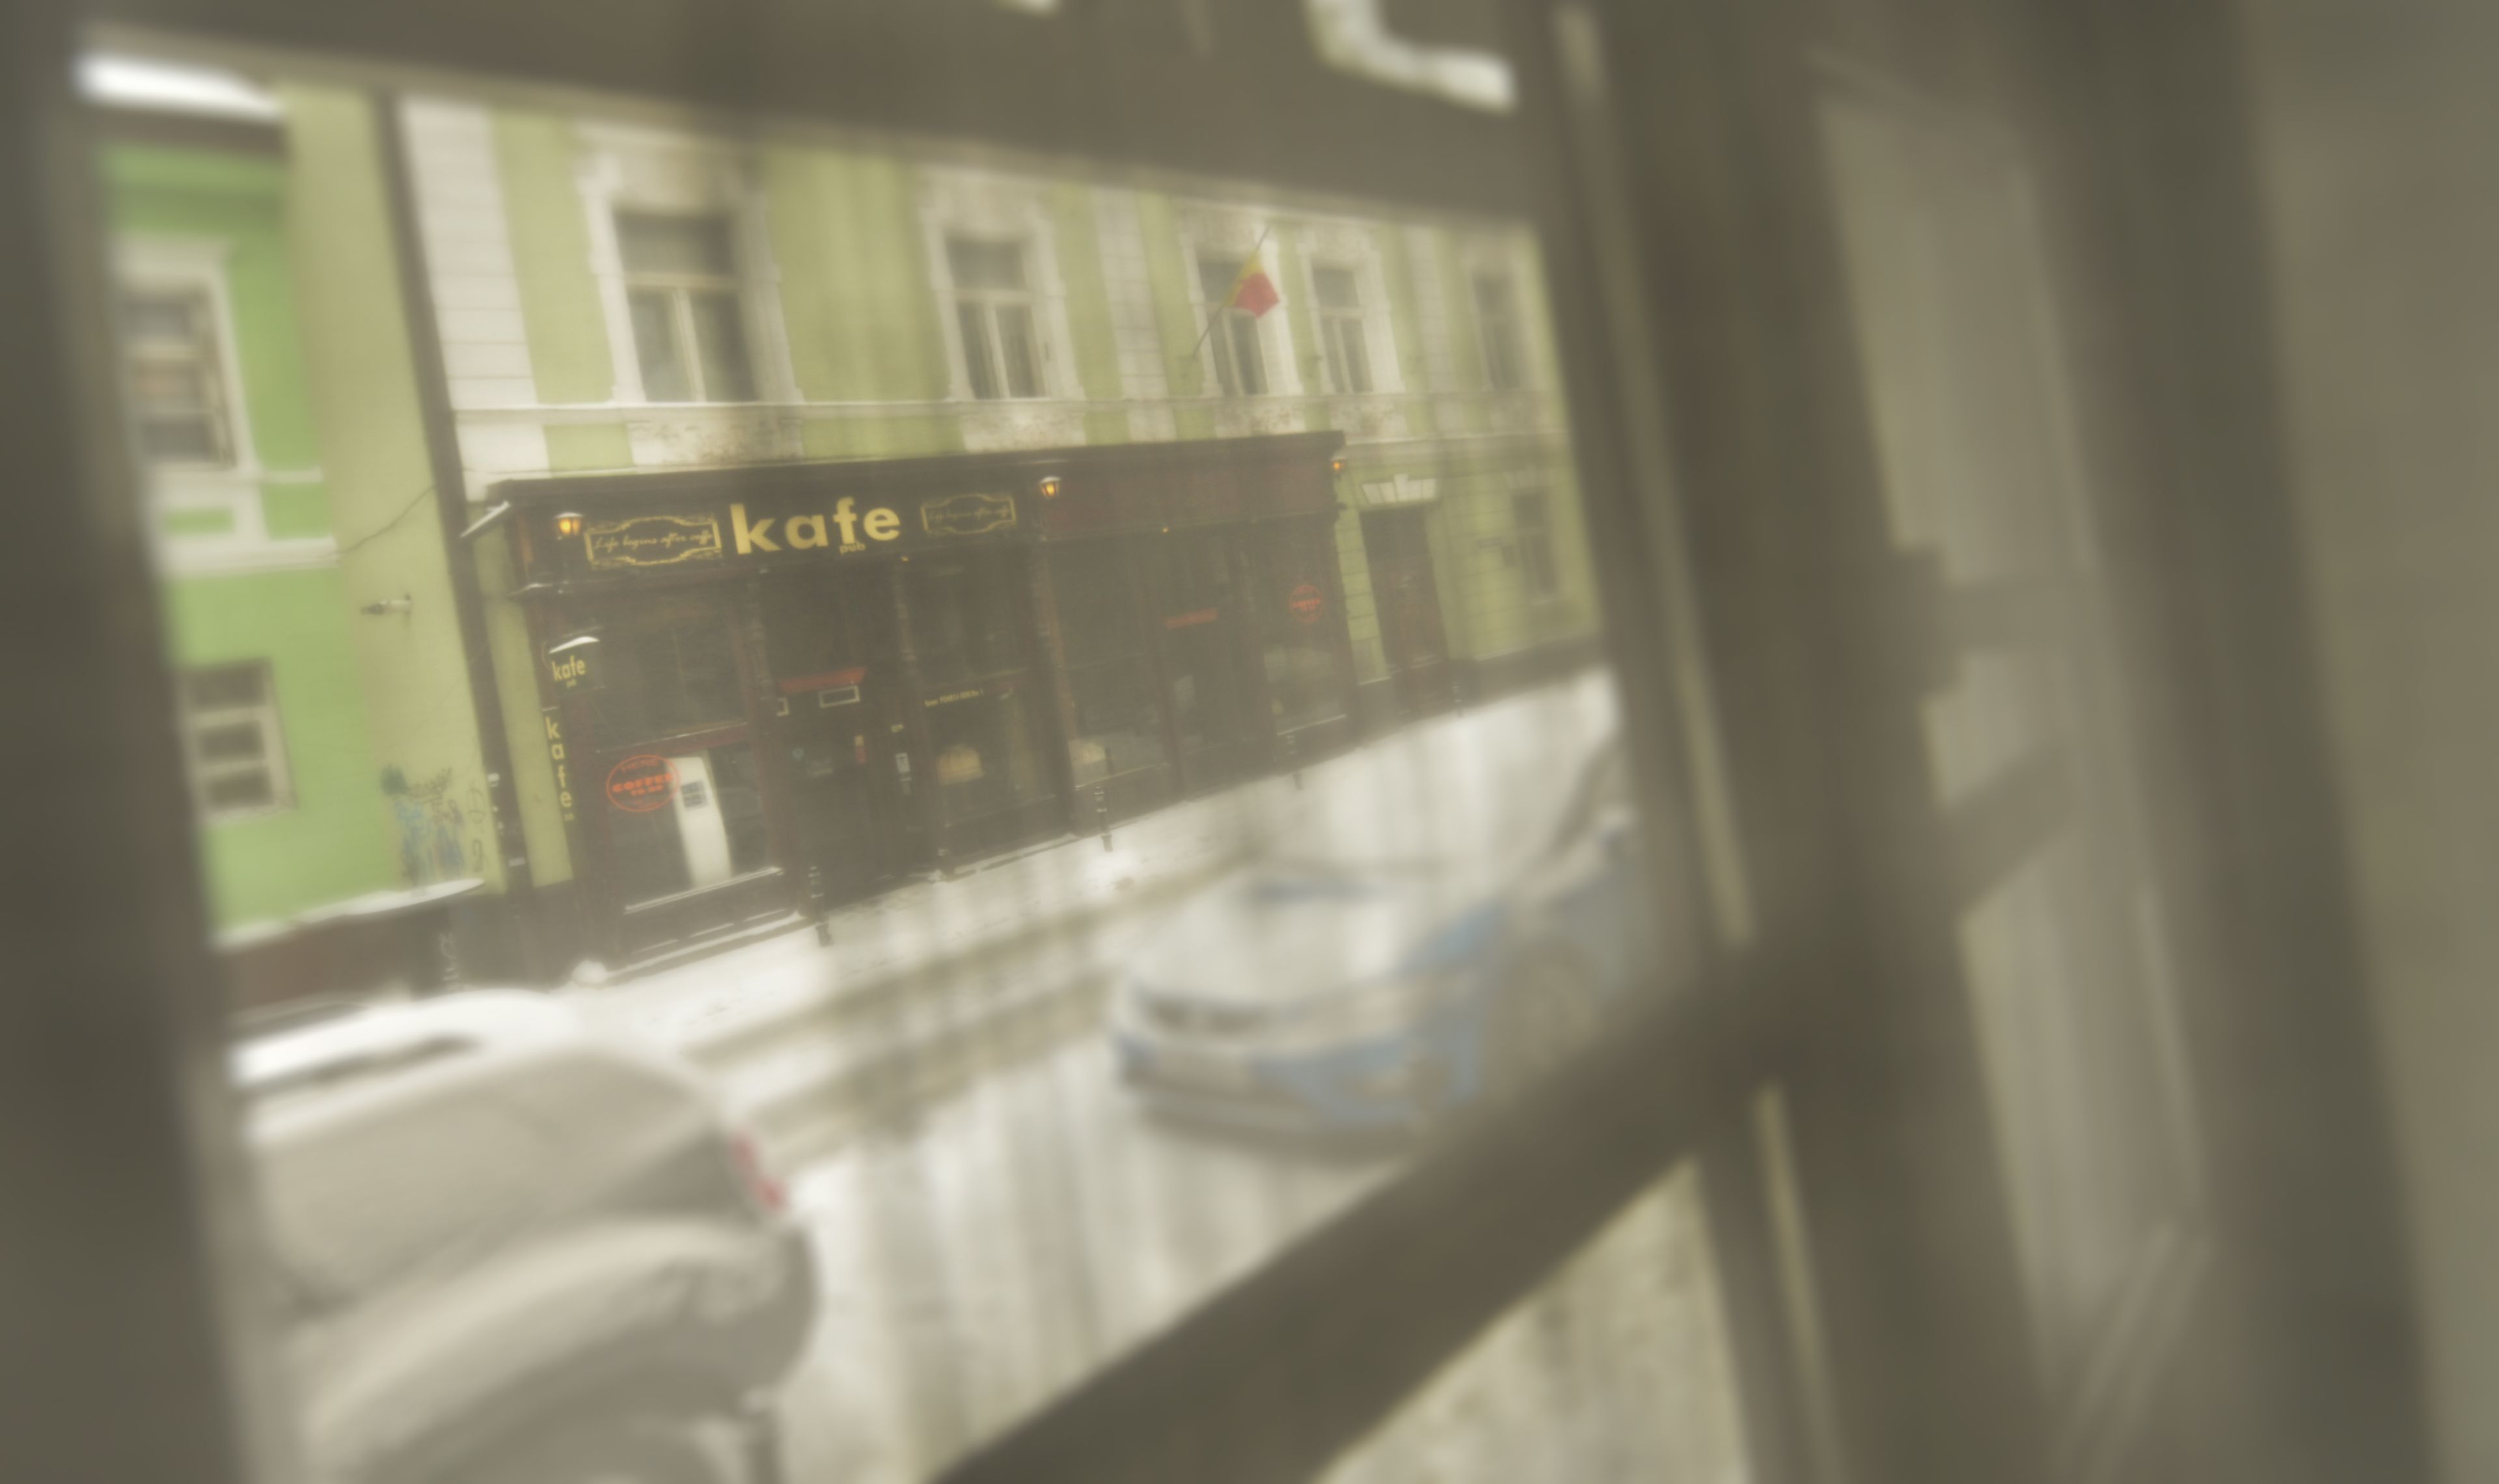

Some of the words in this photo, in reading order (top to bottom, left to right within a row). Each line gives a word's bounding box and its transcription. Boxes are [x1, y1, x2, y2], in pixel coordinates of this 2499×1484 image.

[730, 497, 901, 554] kafe
[622, 534, 657, 550] begins
[661, 532, 687, 548] after
[839, 540, 866, 556] pub
[552, 655, 586, 681] kafe
[545, 716, 573, 809] kafe
